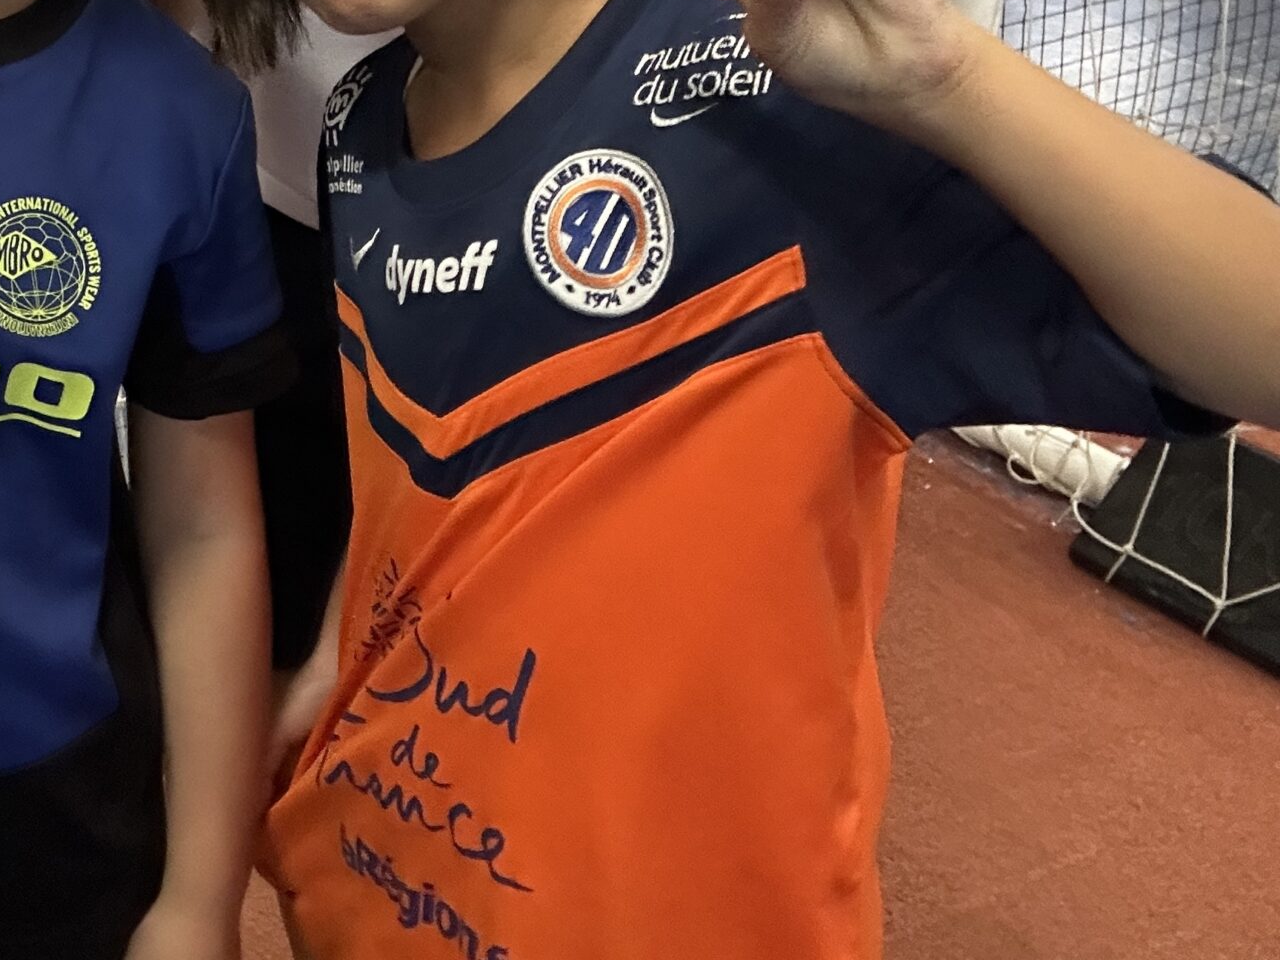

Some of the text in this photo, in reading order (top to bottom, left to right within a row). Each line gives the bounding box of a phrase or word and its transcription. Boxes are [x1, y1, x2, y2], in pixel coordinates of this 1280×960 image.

[633, 62, 773, 105] du soleil
[531, 163, 584, 283] MONTPELLIER
[643, 188, 663, 243] Sport
[76, 227, 102, 274] SPORTS
[385, 239, 498, 304] dyneff
[637, 246, 664, 286] Club
[78, 276, 102, 310] WEAR
[584, 291, 621, 308] 1974
[391, 725, 452, 788] de
[317, 730, 534, 892] rance
